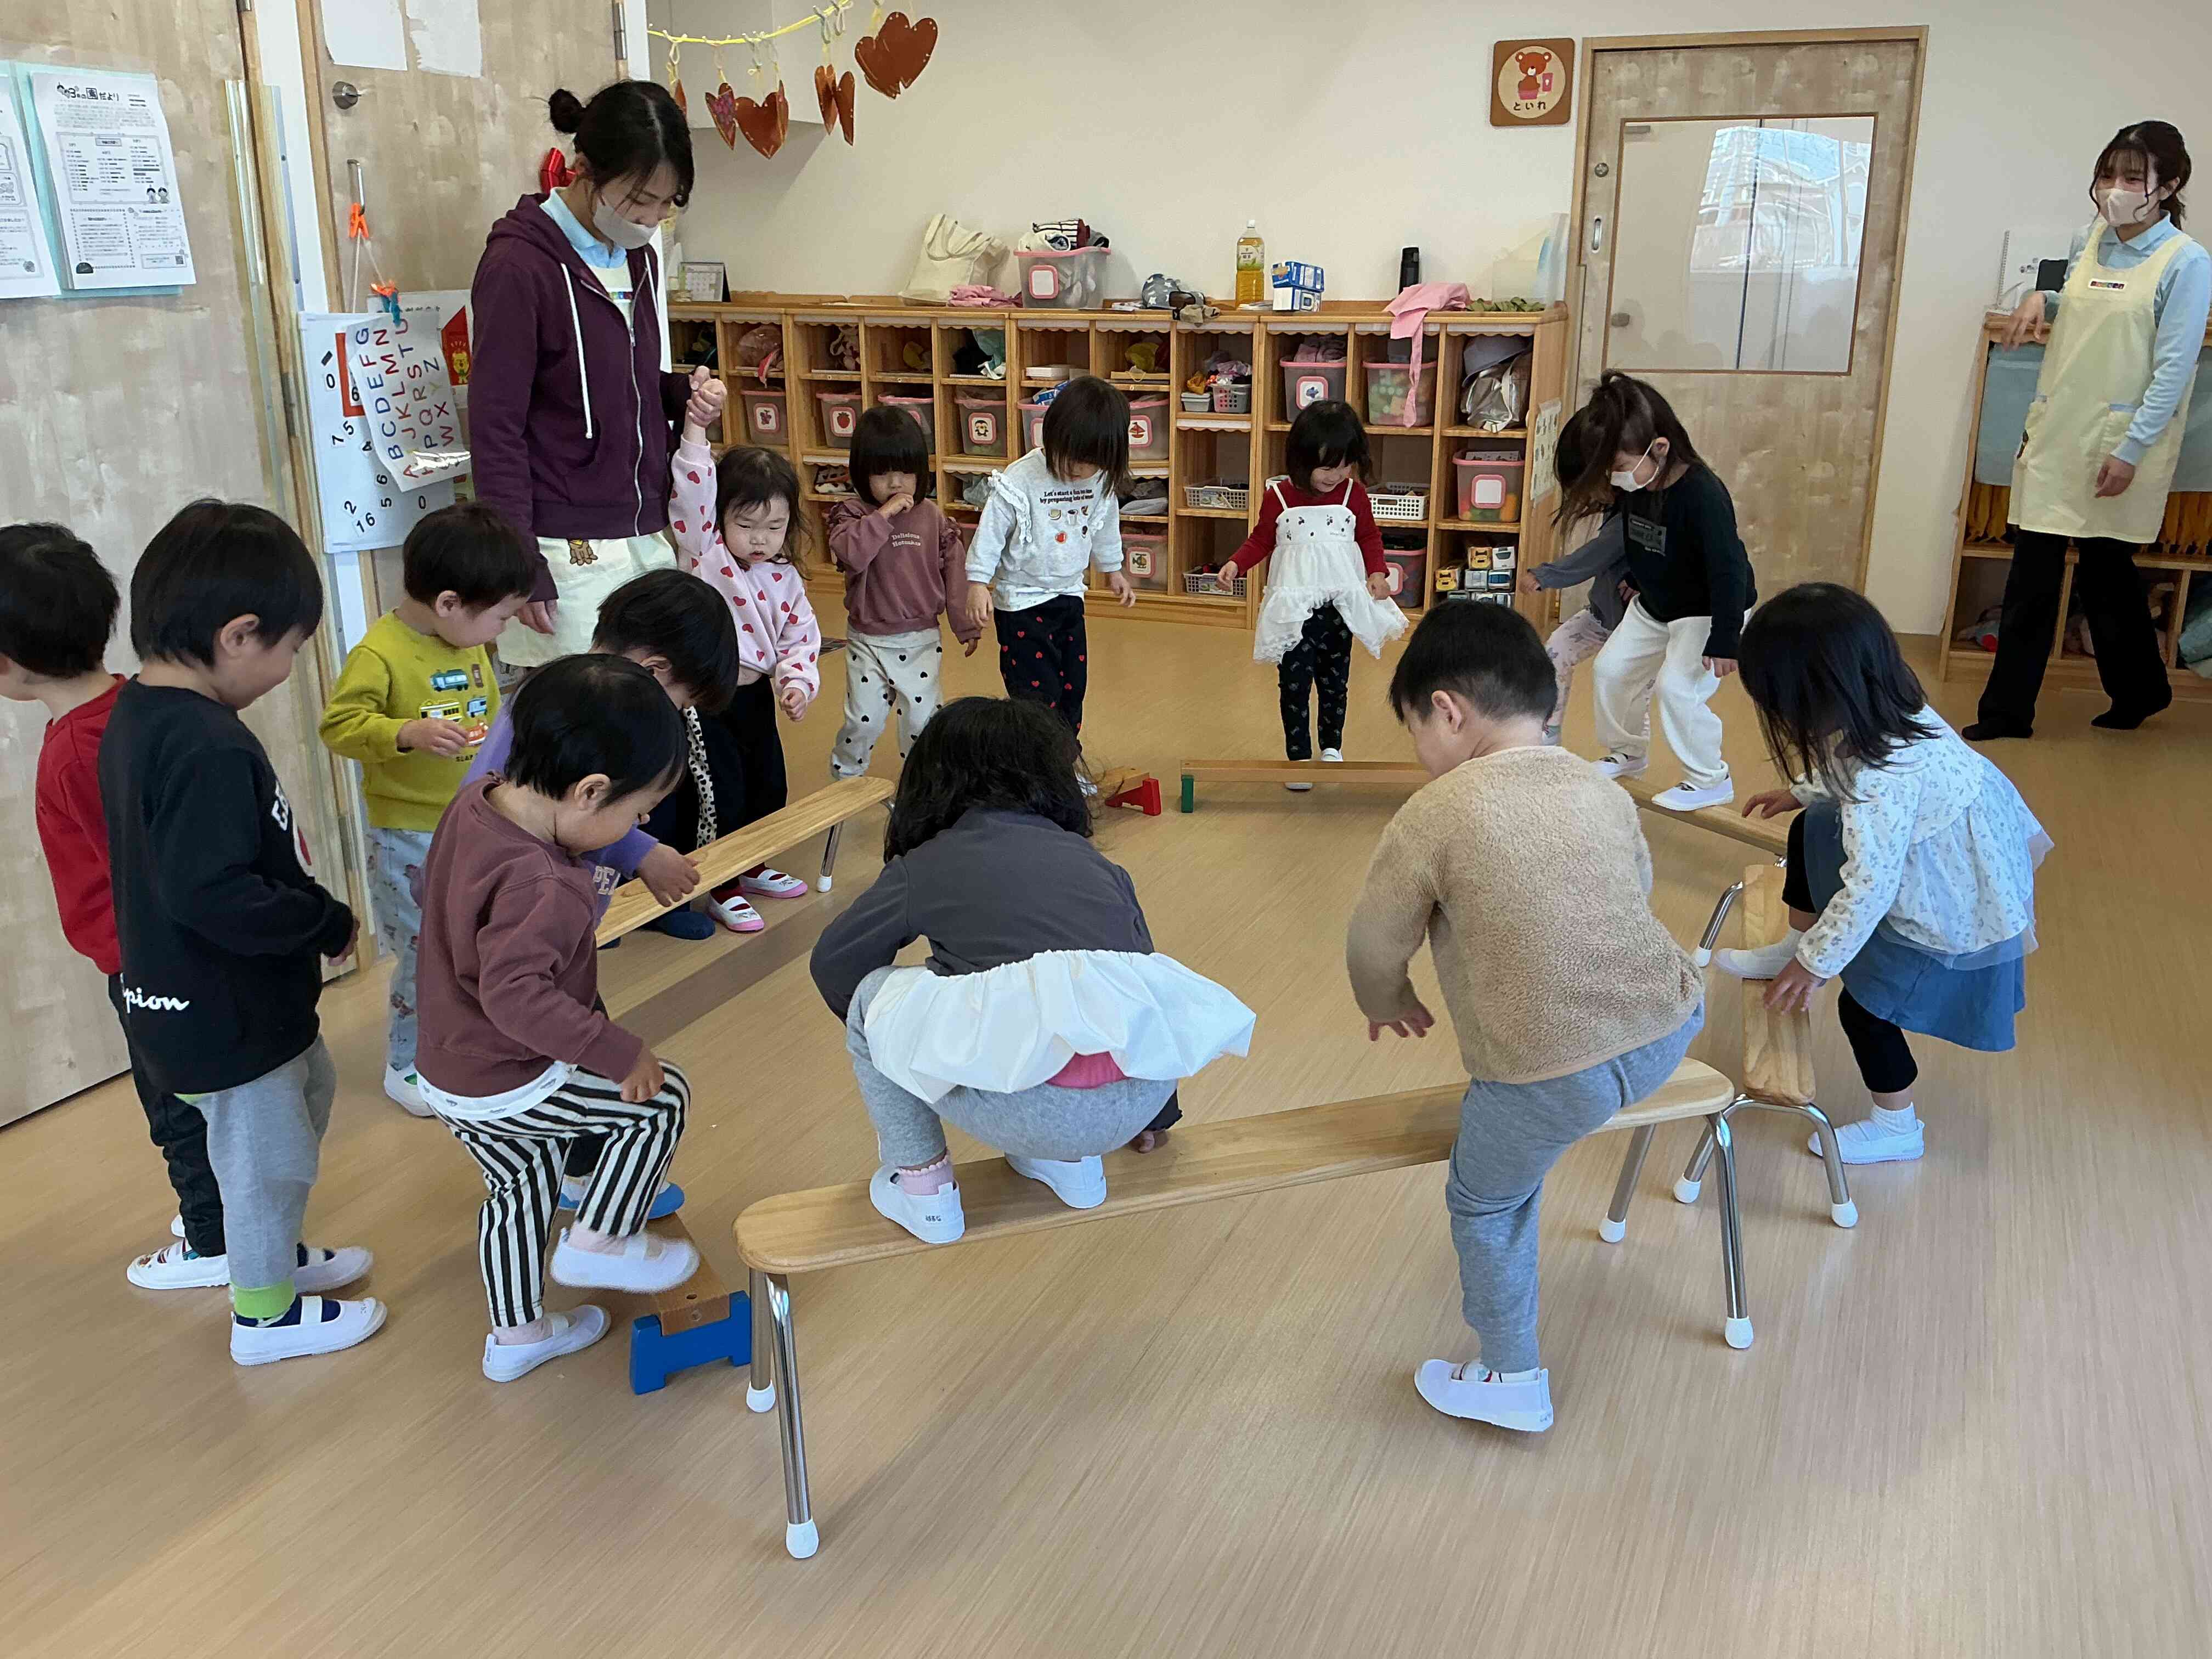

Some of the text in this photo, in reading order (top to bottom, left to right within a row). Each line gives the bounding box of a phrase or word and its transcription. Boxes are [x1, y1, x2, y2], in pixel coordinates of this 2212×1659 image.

[1513, 100, 1546, 111] といれ
[356, 328, 369, 345] G
[398, 343, 414, 358] T
[359, 354, 377, 366] F
[423, 357, 439, 373] Z
[407, 365, 422, 379] S
[367, 374, 383, 389] E
[373, 329, 416, 439] J K L M N
[413, 386, 427, 402] R
[375, 398, 391, 414] D
[434, 402, 449, 417] X
[419, 408, 433, 426] Q
[343, 420, 354, 435] 5
[382, 421, 396, 437] C
[424, 435, 438, 448] P
[439, 426, 454, 447] W
[388, 444, 404, 459] B
[344, 501, 357, 514] 2
[381, 498, 392, 507] 5
[122, 986, 190, 1014] pion
